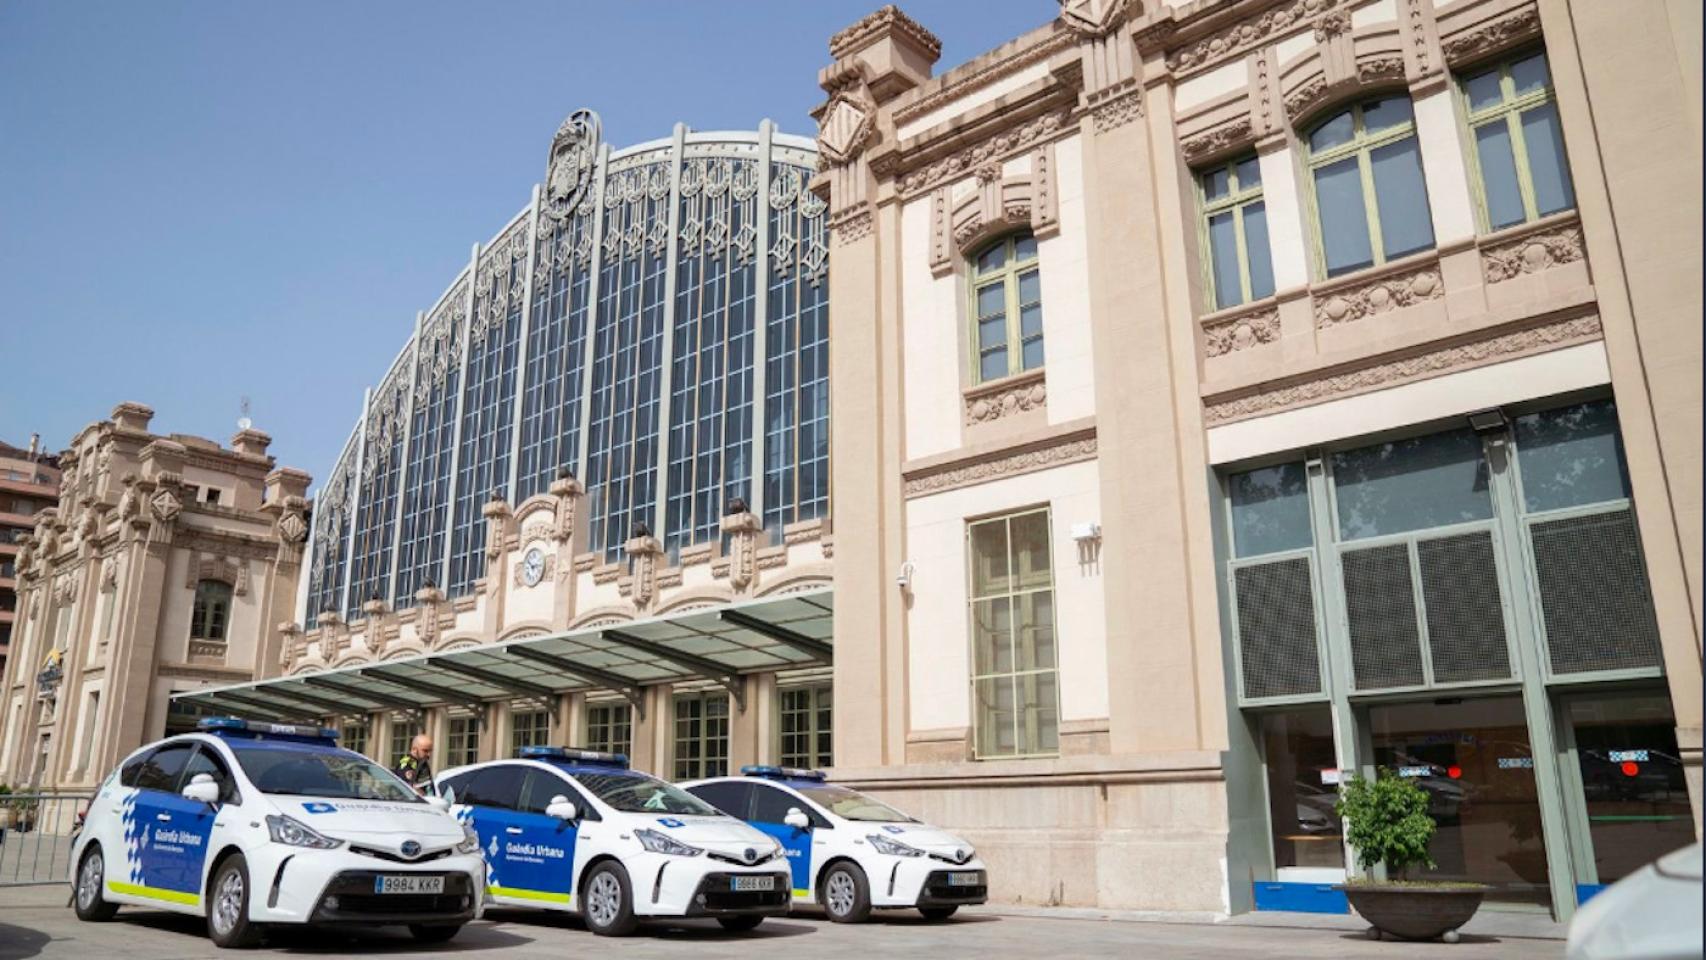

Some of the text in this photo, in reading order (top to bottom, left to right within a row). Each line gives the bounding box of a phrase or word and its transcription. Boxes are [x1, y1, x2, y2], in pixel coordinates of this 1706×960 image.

[536, 844, 564, 858] Urbana
[385, 878, 441, 892] 9984 KKR
